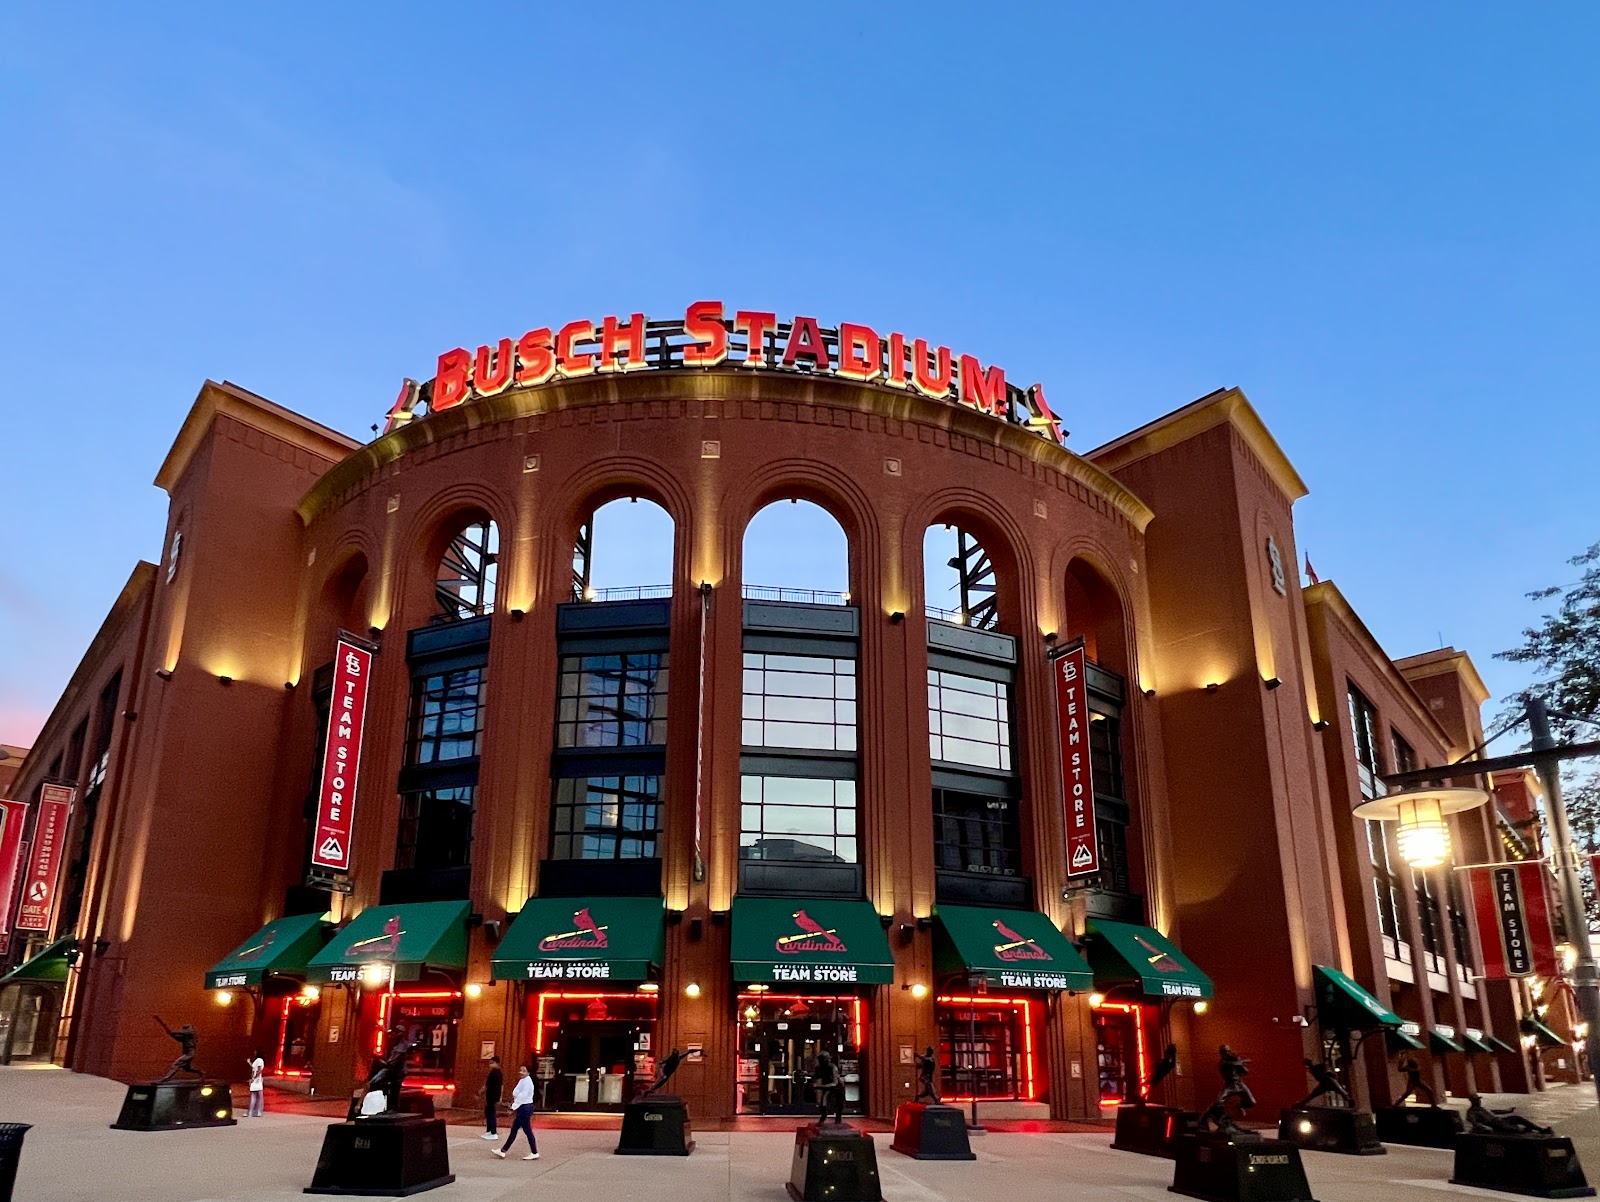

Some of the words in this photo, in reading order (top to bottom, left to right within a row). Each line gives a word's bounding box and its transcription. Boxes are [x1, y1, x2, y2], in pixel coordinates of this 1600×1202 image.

[431, 312, 651, 413] BUSCH
[683, 300, 1008, 416] STADIUM
[338, 680, 356, 740] TEAM
[1066, 687, 1080, 746] TEAM
[330, 746, 348, 821] STORE
[1071, 752, 1085, 828] STORE
[1501, 873, 1516, 912] TEAM
[22, 904, 42, 915] GATE
[1508, 918, 1524, 969] STORE
[330, 970, 356, 981] TEAM
[527, 966, 563, 978] TEAM
[566, 966, 610, 978] STORE
[772, 968, 811, 980] TEAM
[814, 969, 857, 982] STORE
[215, 977, 229, 987] TEAM
[229, 975, 247, 986] STORE
[1000, 975, 1031, 987] TEAM
[1034, 976, 1067, 989] STORE
[1162, 984, 1181, 995] TEAM
[1182, 986, 1202, 997] STORE
[959, 1012, 981, 1021] LADES
